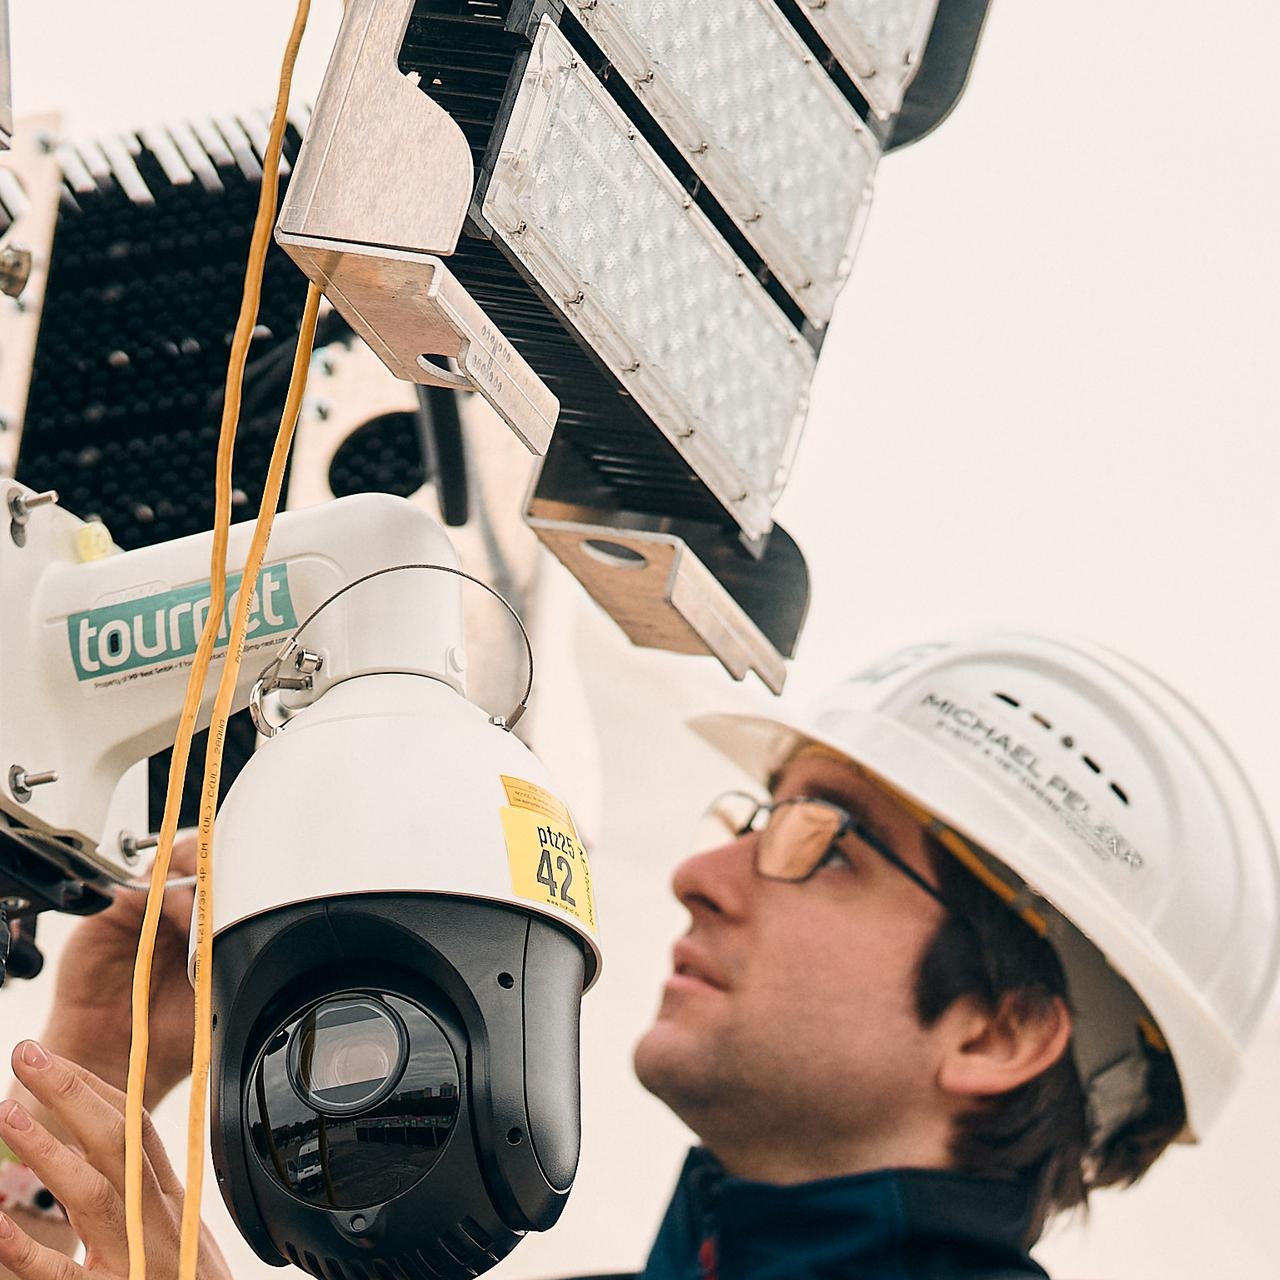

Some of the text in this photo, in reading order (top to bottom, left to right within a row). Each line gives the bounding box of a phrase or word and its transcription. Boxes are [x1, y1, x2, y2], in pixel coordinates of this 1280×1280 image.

[77, 571, 281, 673] tournet
[922, 692, 1042, 780] MICHAEL
[199, 842, 209, 859] CM
[536, 825, 576, 860] ptz25
[536, 848, 577, 908] 42
